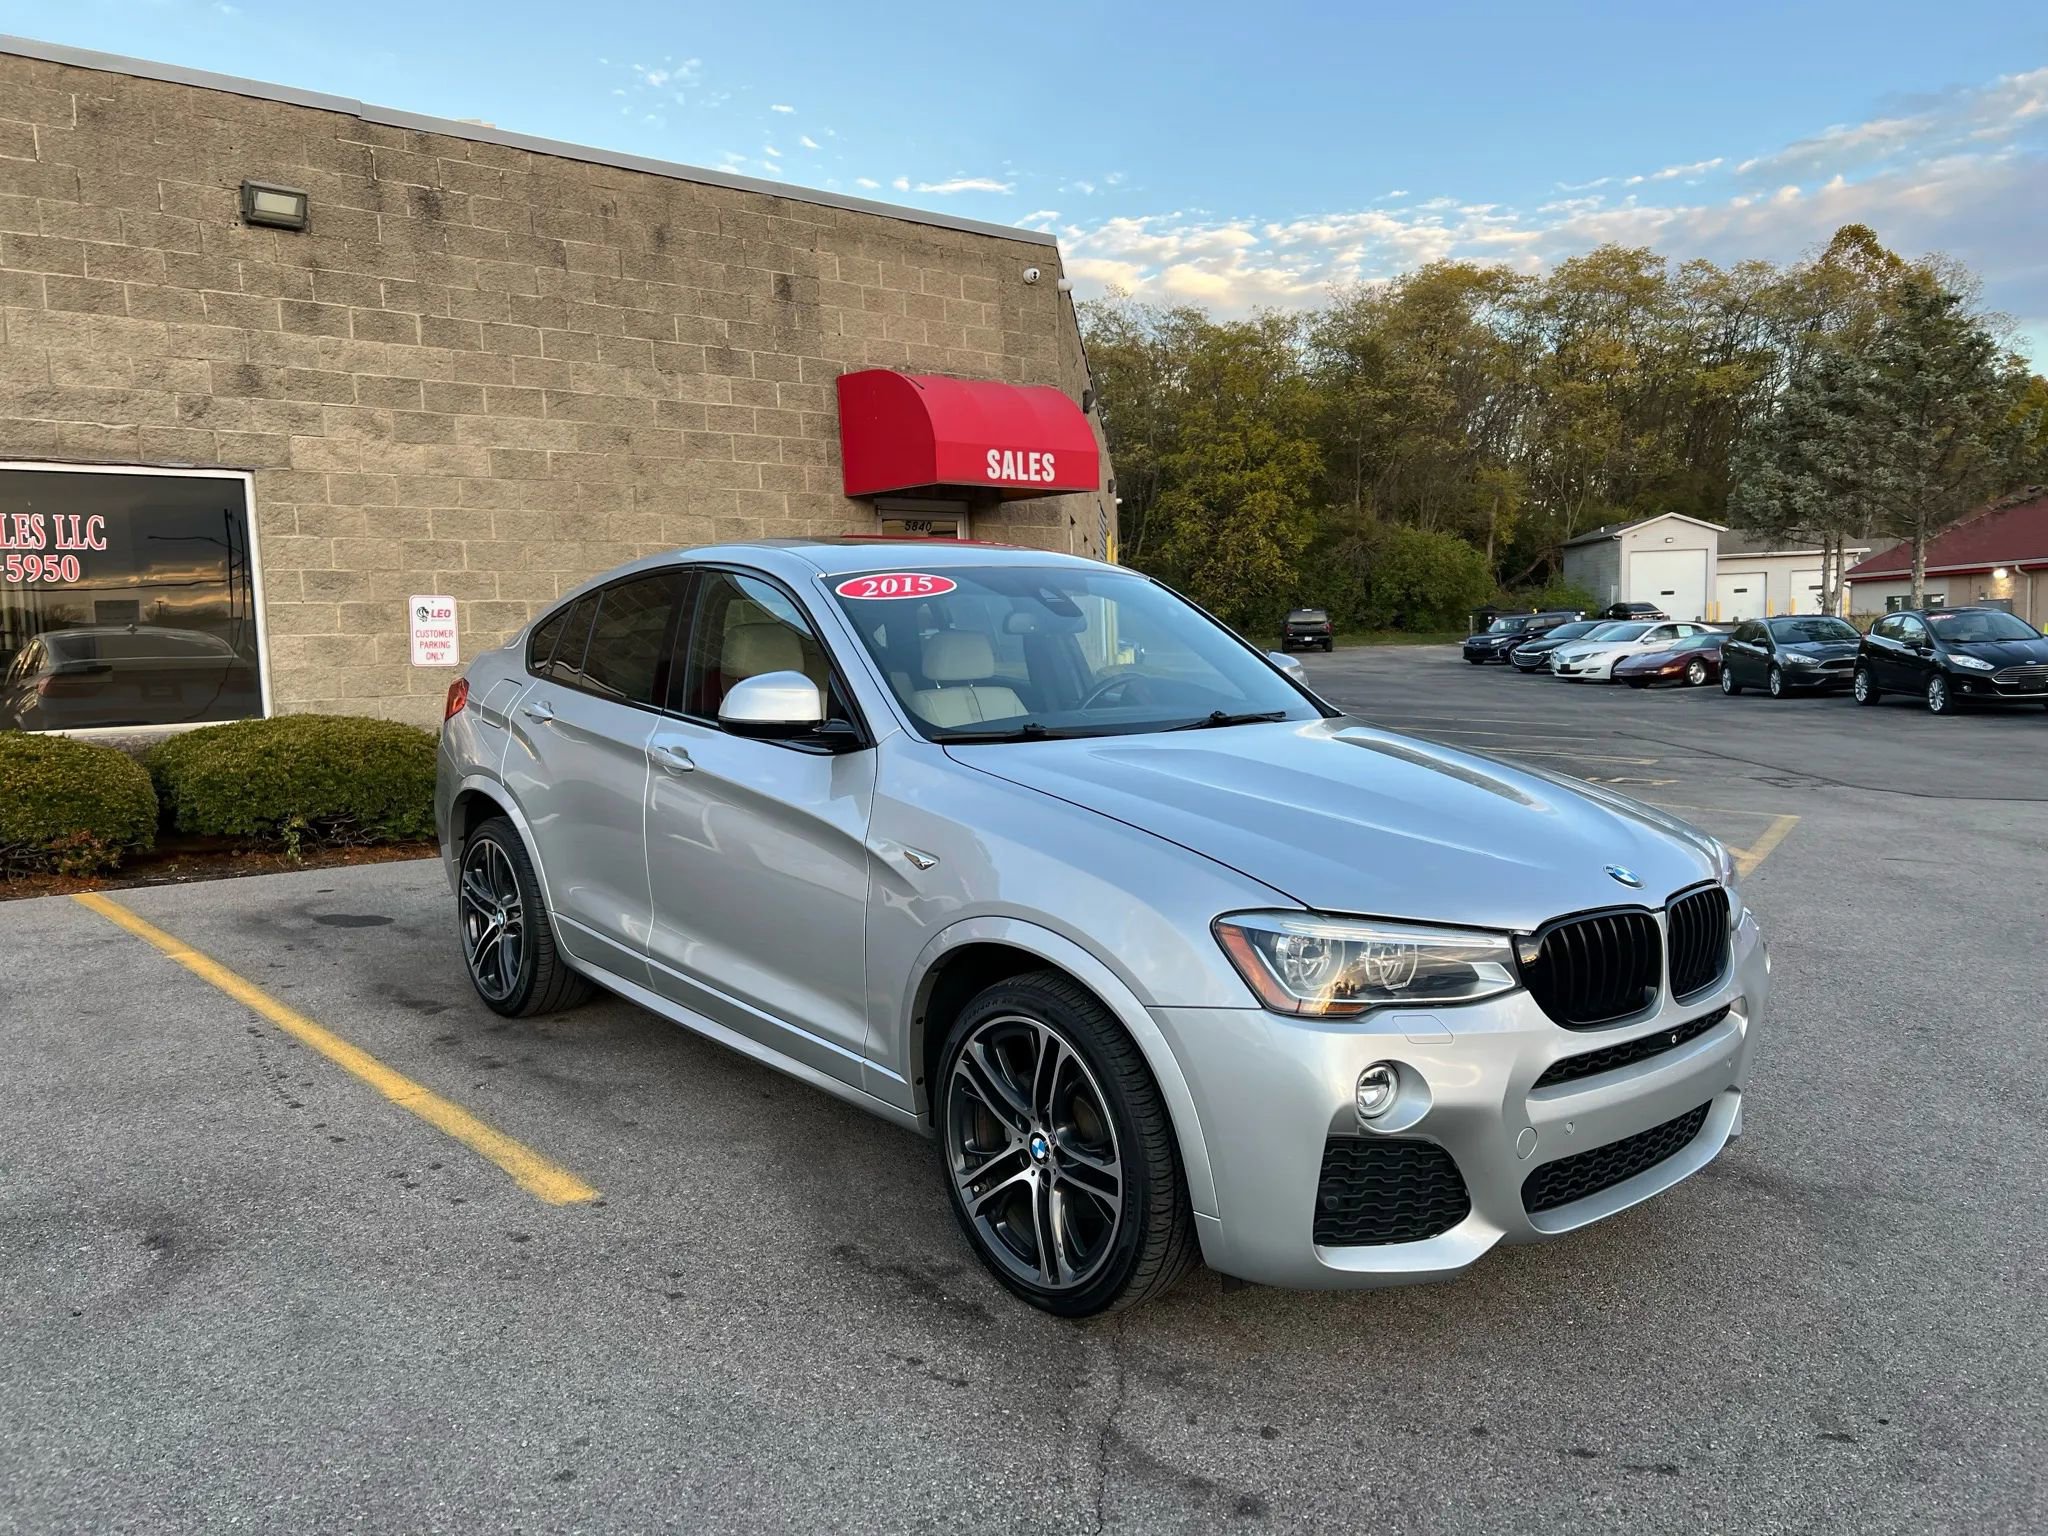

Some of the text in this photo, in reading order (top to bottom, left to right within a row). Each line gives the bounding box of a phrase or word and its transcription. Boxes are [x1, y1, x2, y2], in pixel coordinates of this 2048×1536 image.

[986, 449, 1055, 482] SALES
[904, 520, 931, 531] 5840
[0, 513, 107, 550] LES LLC
[862, 576, 934, 596] 2015
[431, 609, 451, 618] LEO
[415, 630, 453, 638] CUSTOMER
[420, 641, 451, 649] PARKING
[425, 652, 445, 661] ONLY
